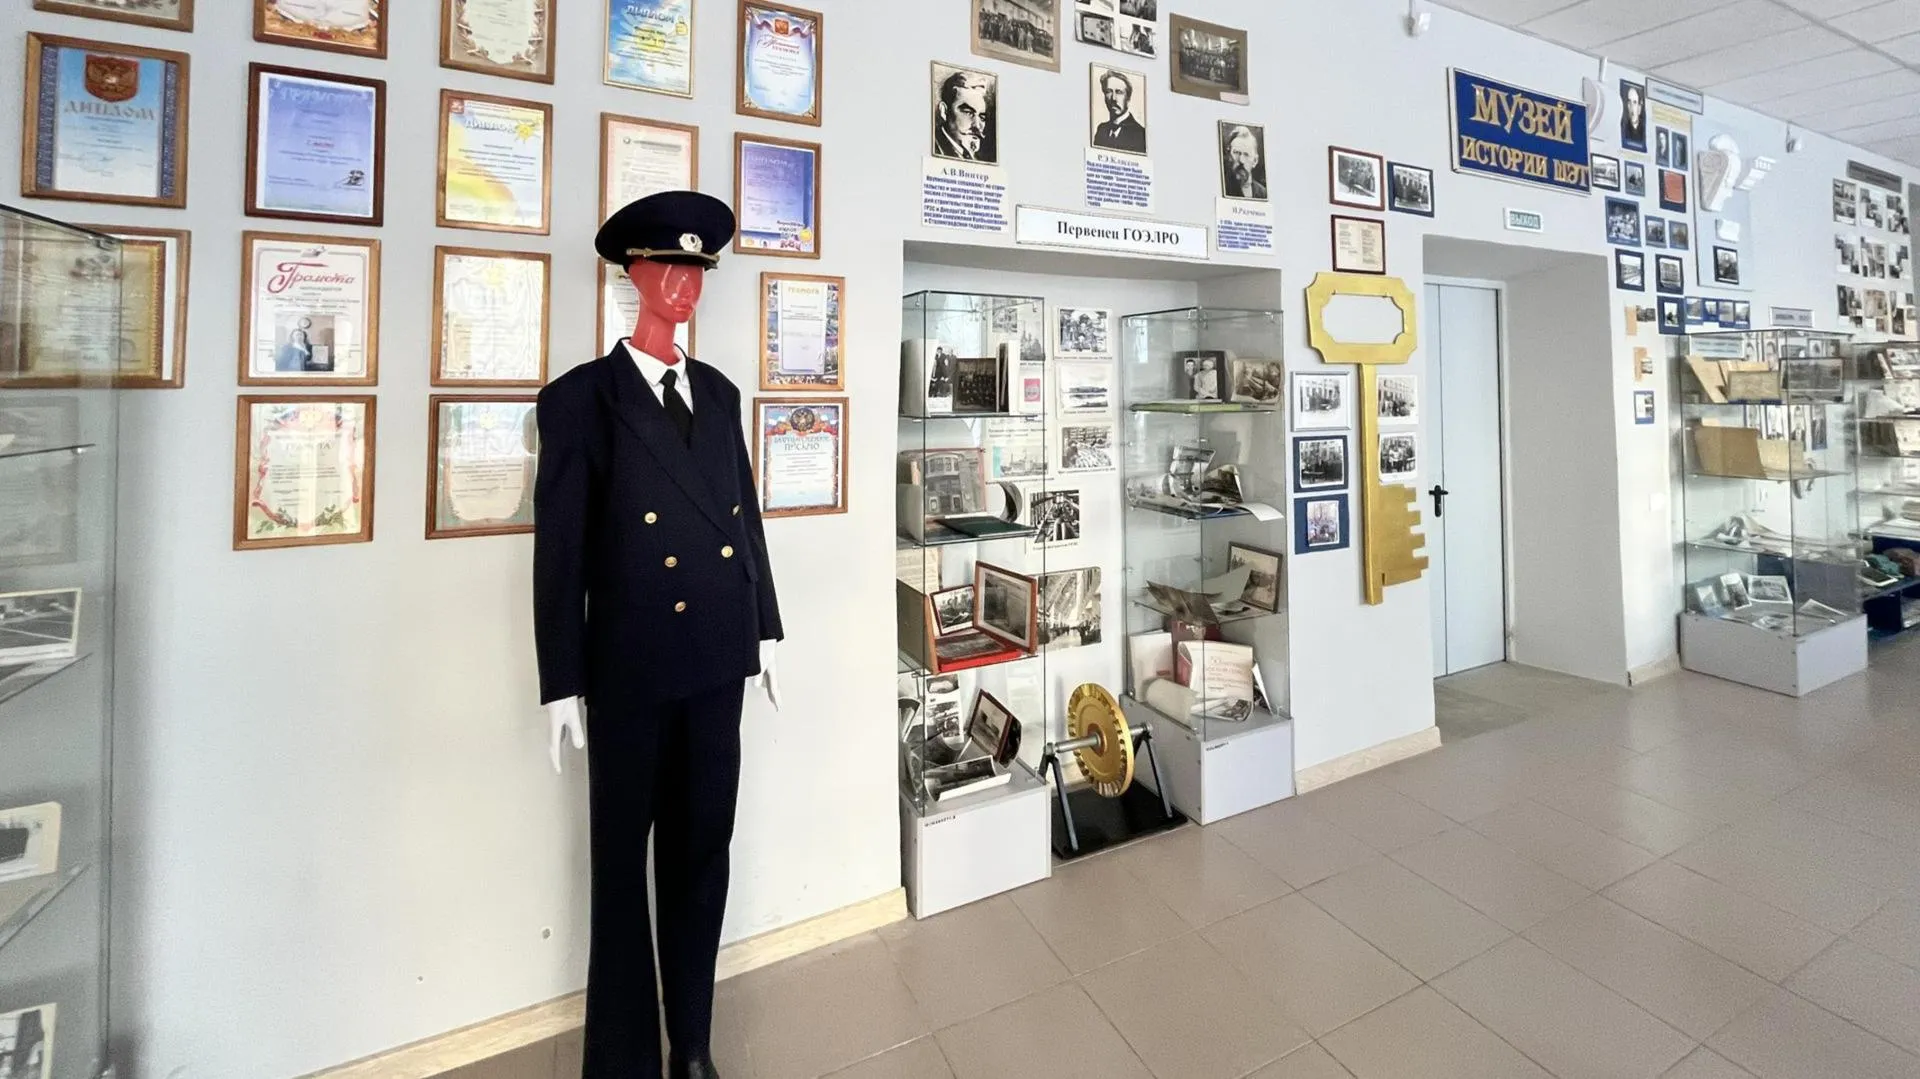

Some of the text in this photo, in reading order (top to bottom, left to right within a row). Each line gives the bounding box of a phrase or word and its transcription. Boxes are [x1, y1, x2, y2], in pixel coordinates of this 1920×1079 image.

[64, 100, 155, 120] ДИПЛОМ
[1470, 83, 1574, 144] МУЗЕЙ
[1460, 135, 1548, 178] ИСТОРИИ
[941, 168, 989, 182] А.В.Винтер
[1510, 212, 1540, 228] ВЫХОД
[1057, 221, 1180, 245] Первенец ГОЭЛРО
[267, 262, 356, 294] Грамота
